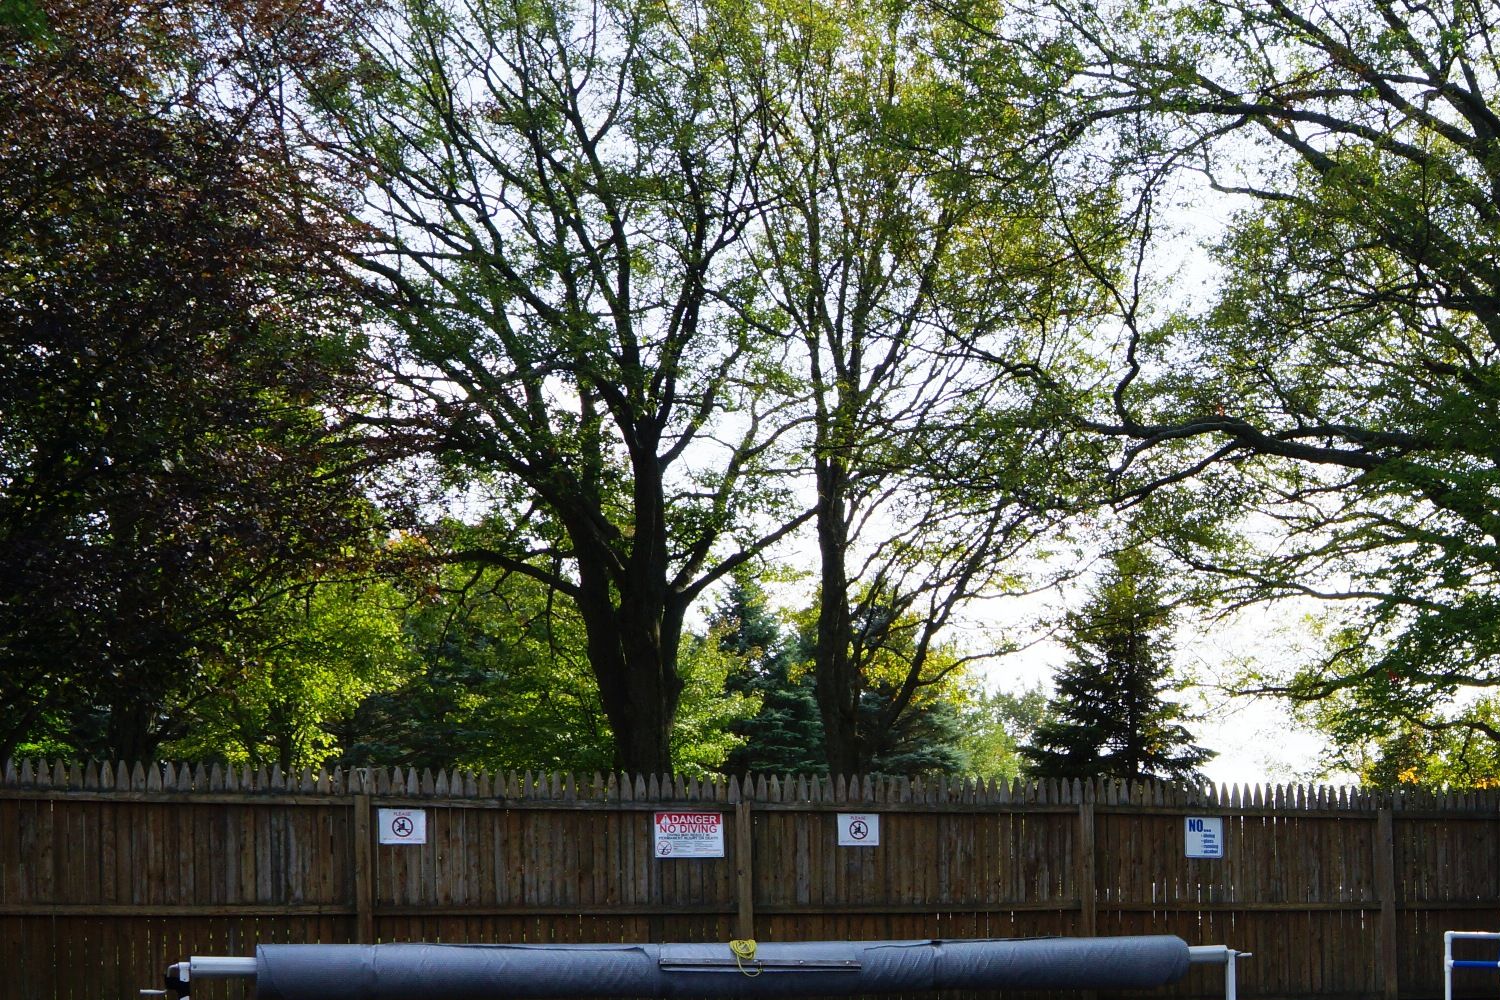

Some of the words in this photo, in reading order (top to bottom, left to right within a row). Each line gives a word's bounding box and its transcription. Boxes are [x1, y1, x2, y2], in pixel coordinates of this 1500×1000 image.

[671, 815, 717, 824] DANGER
[659, 824, 676, 833] NO
[679, 824, 718, 833] DIVING
